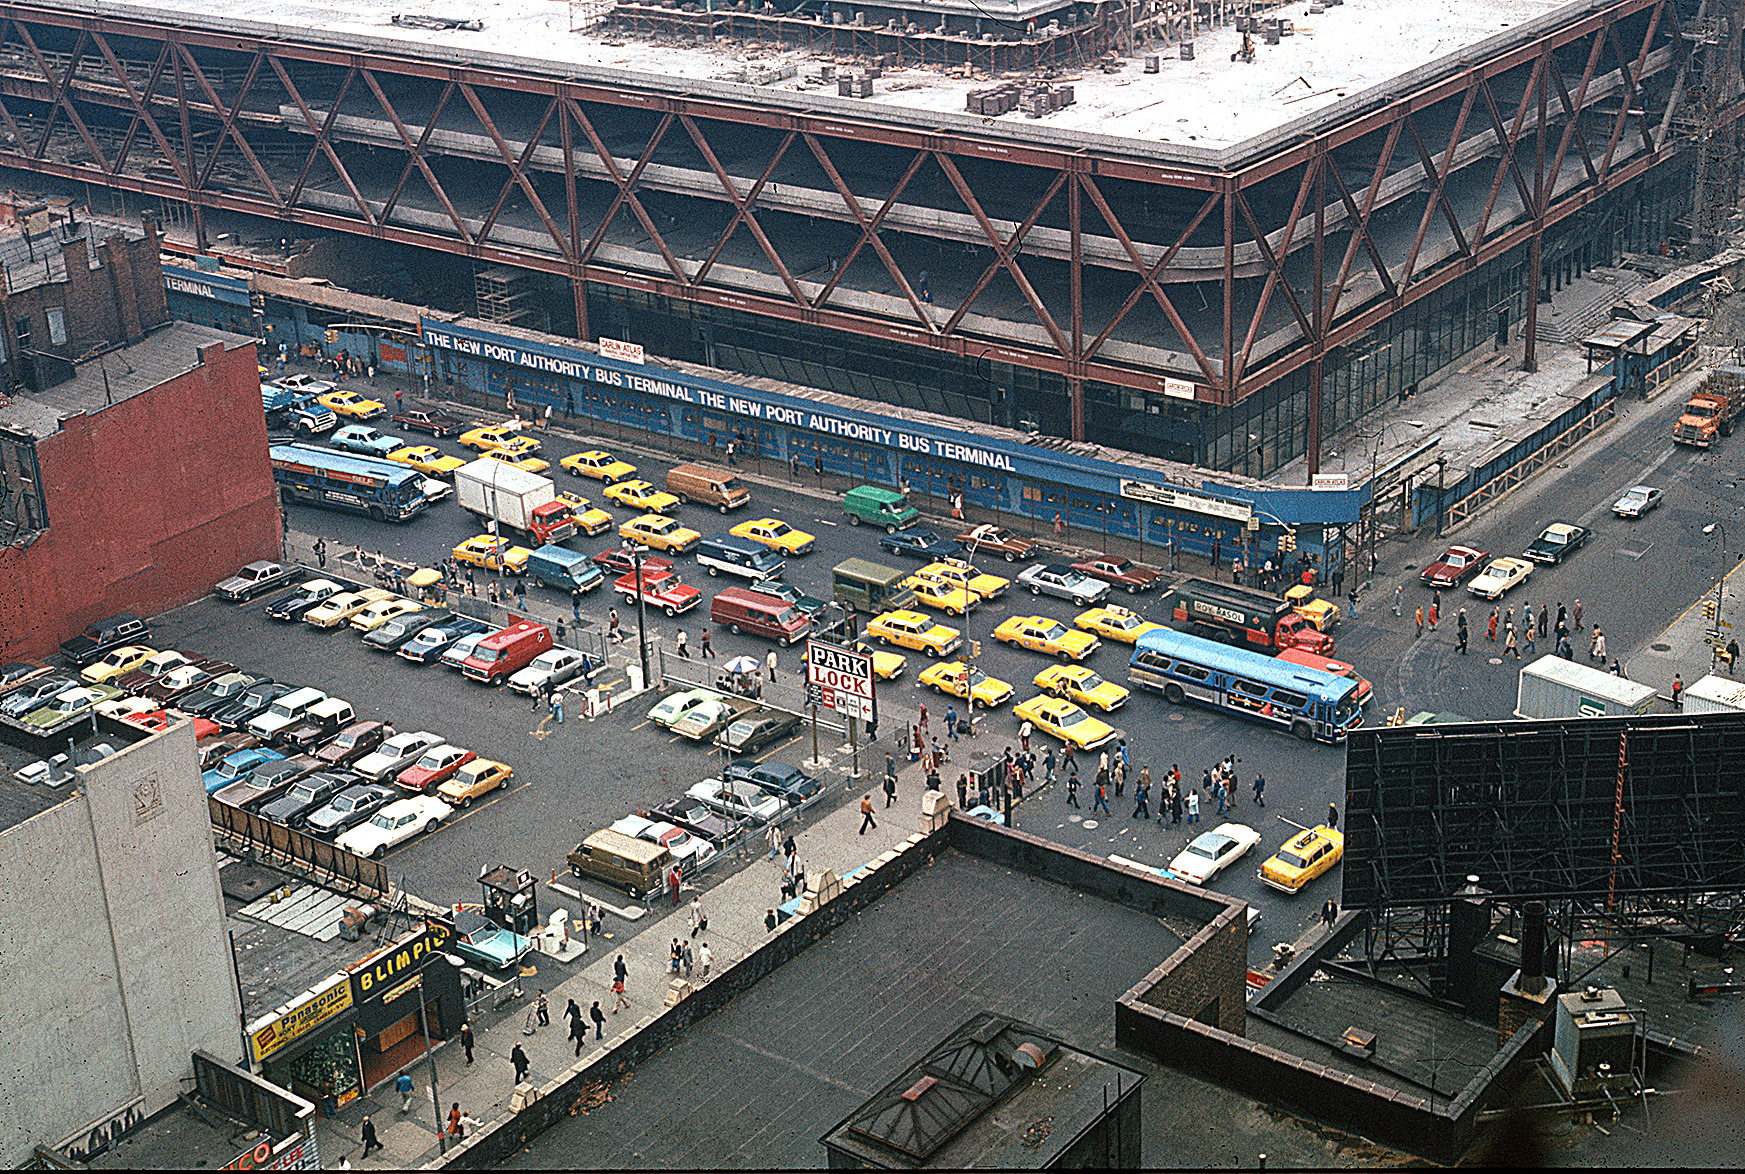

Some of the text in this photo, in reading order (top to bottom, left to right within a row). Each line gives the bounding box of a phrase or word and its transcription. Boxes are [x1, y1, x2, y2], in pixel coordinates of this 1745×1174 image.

[163, 276, 215, 298] TERMINAL
[426, 331, 1016, 472] THE NEW PORT AUTHORITY BUS TERMINAL THE NEW PORT AUTHORITY BUS TERMINAL
[1196, 603, 1213, 613] ROY
[813, 647, 866, 677] PARK
[814, 666, 867, 695] LOCK
[281, 985, 346, 1029] Panasonic
